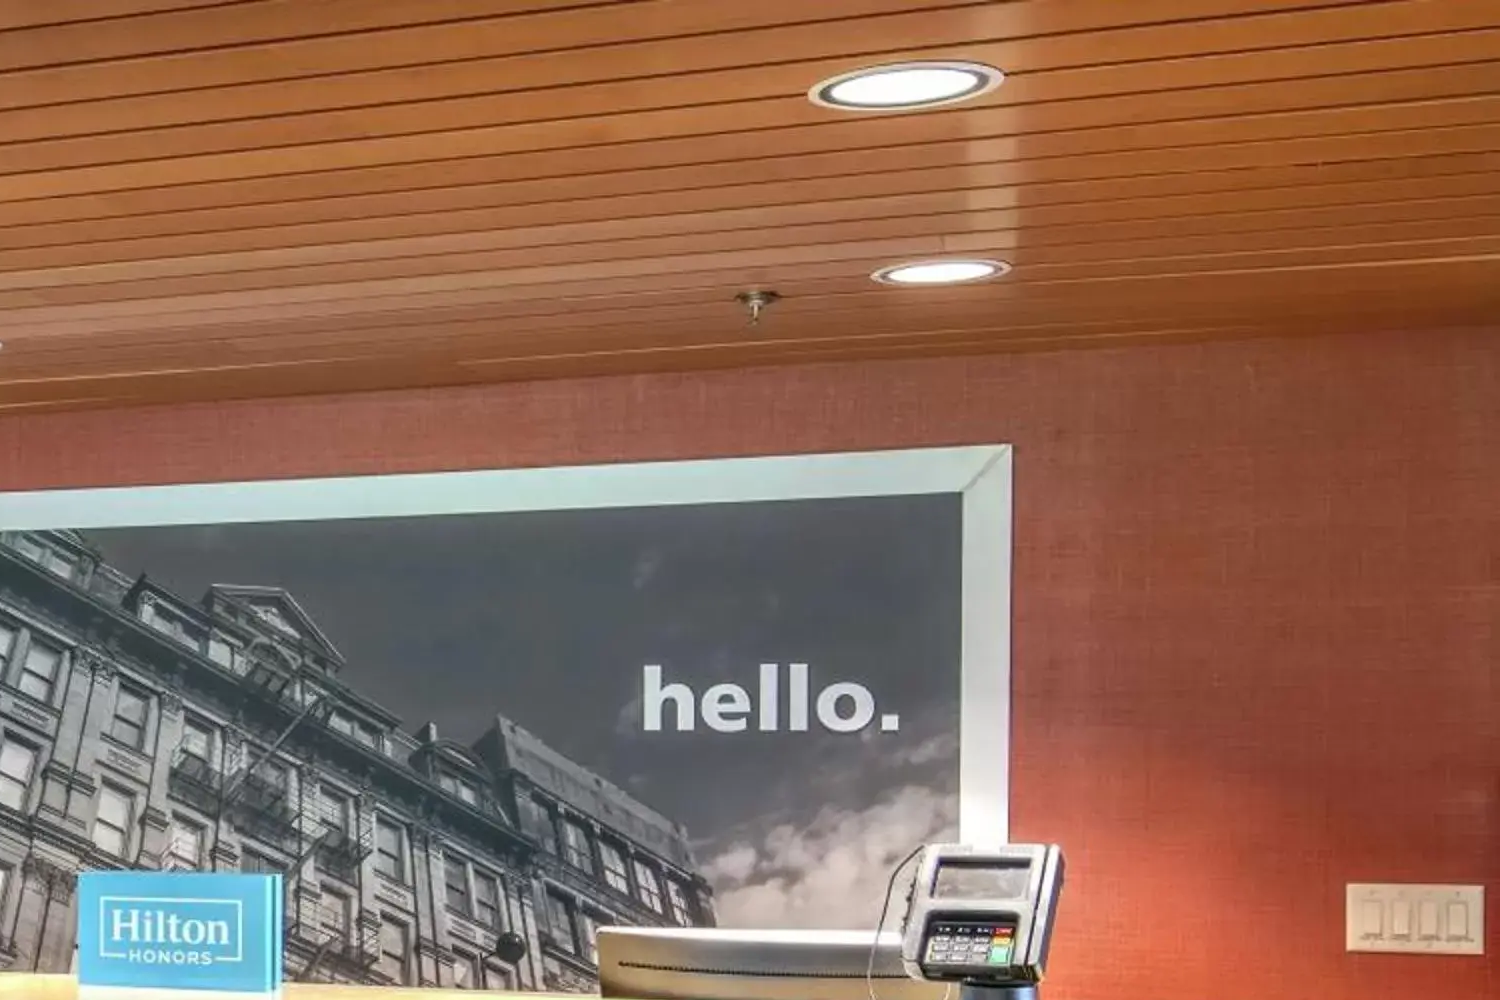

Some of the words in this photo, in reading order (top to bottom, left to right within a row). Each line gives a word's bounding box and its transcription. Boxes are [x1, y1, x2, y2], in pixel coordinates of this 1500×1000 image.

[643, 663, 900, 732] hello.
[112, 909, 230, 945] Hilton
[129, 949, 213, 966] HONORS
